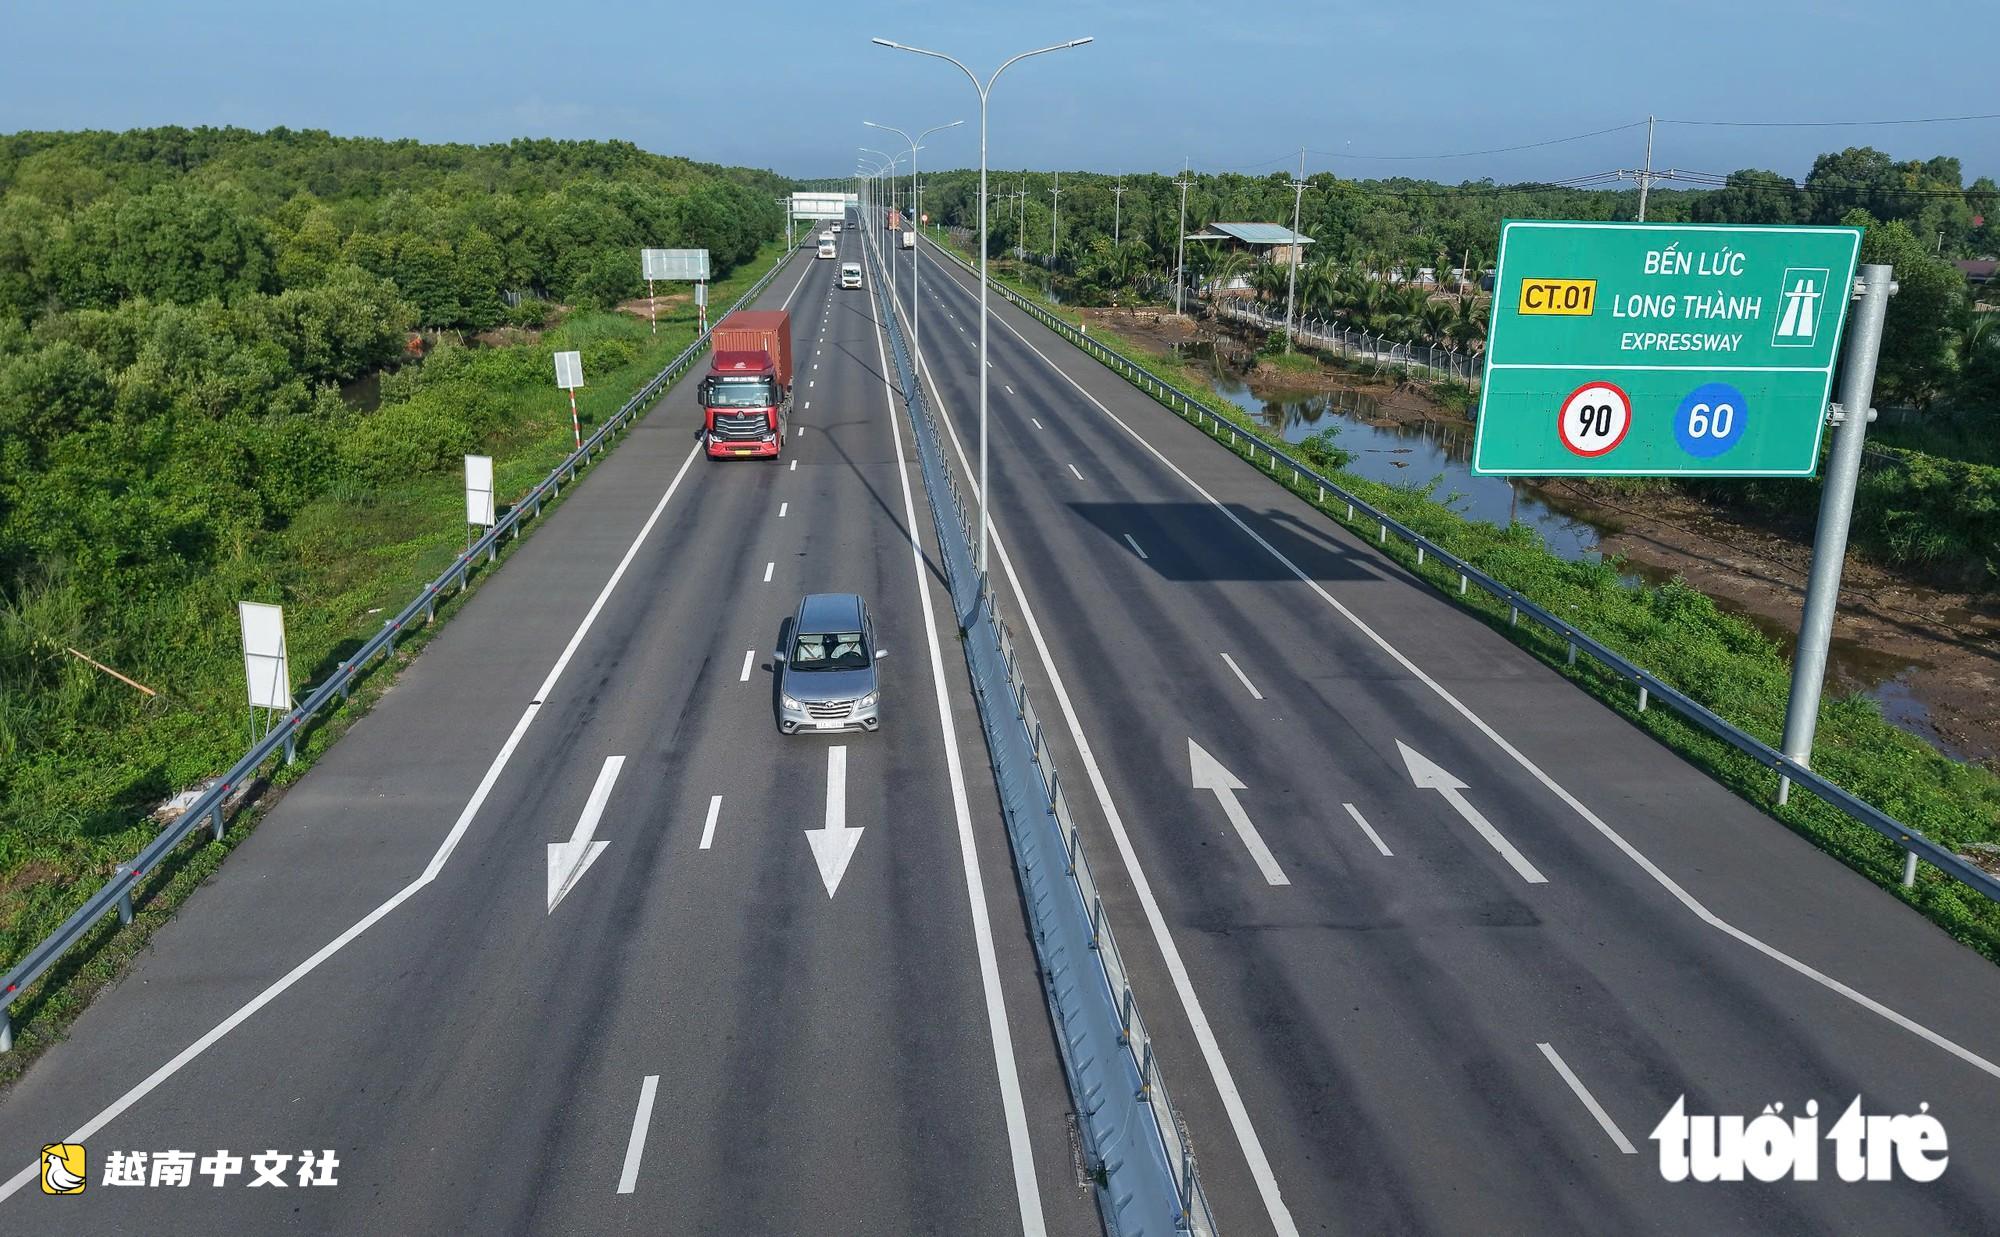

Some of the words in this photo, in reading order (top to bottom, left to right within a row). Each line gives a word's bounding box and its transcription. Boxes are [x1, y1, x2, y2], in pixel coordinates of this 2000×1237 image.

[1644, 242, 1690, 273] BẾN
[1698, 246, 1744, 274] LỨC
[1525, 284, 1589, 309] CT.01
[1612, 294, 1674, 316] LONG
[1684, 290, 1760, 318] THÀNH
[1620, 332, 1741, 350] EXPRESSWAY
[1579, 404, 1610, 435] 90
[1688, 403, 1732, 436] 60
